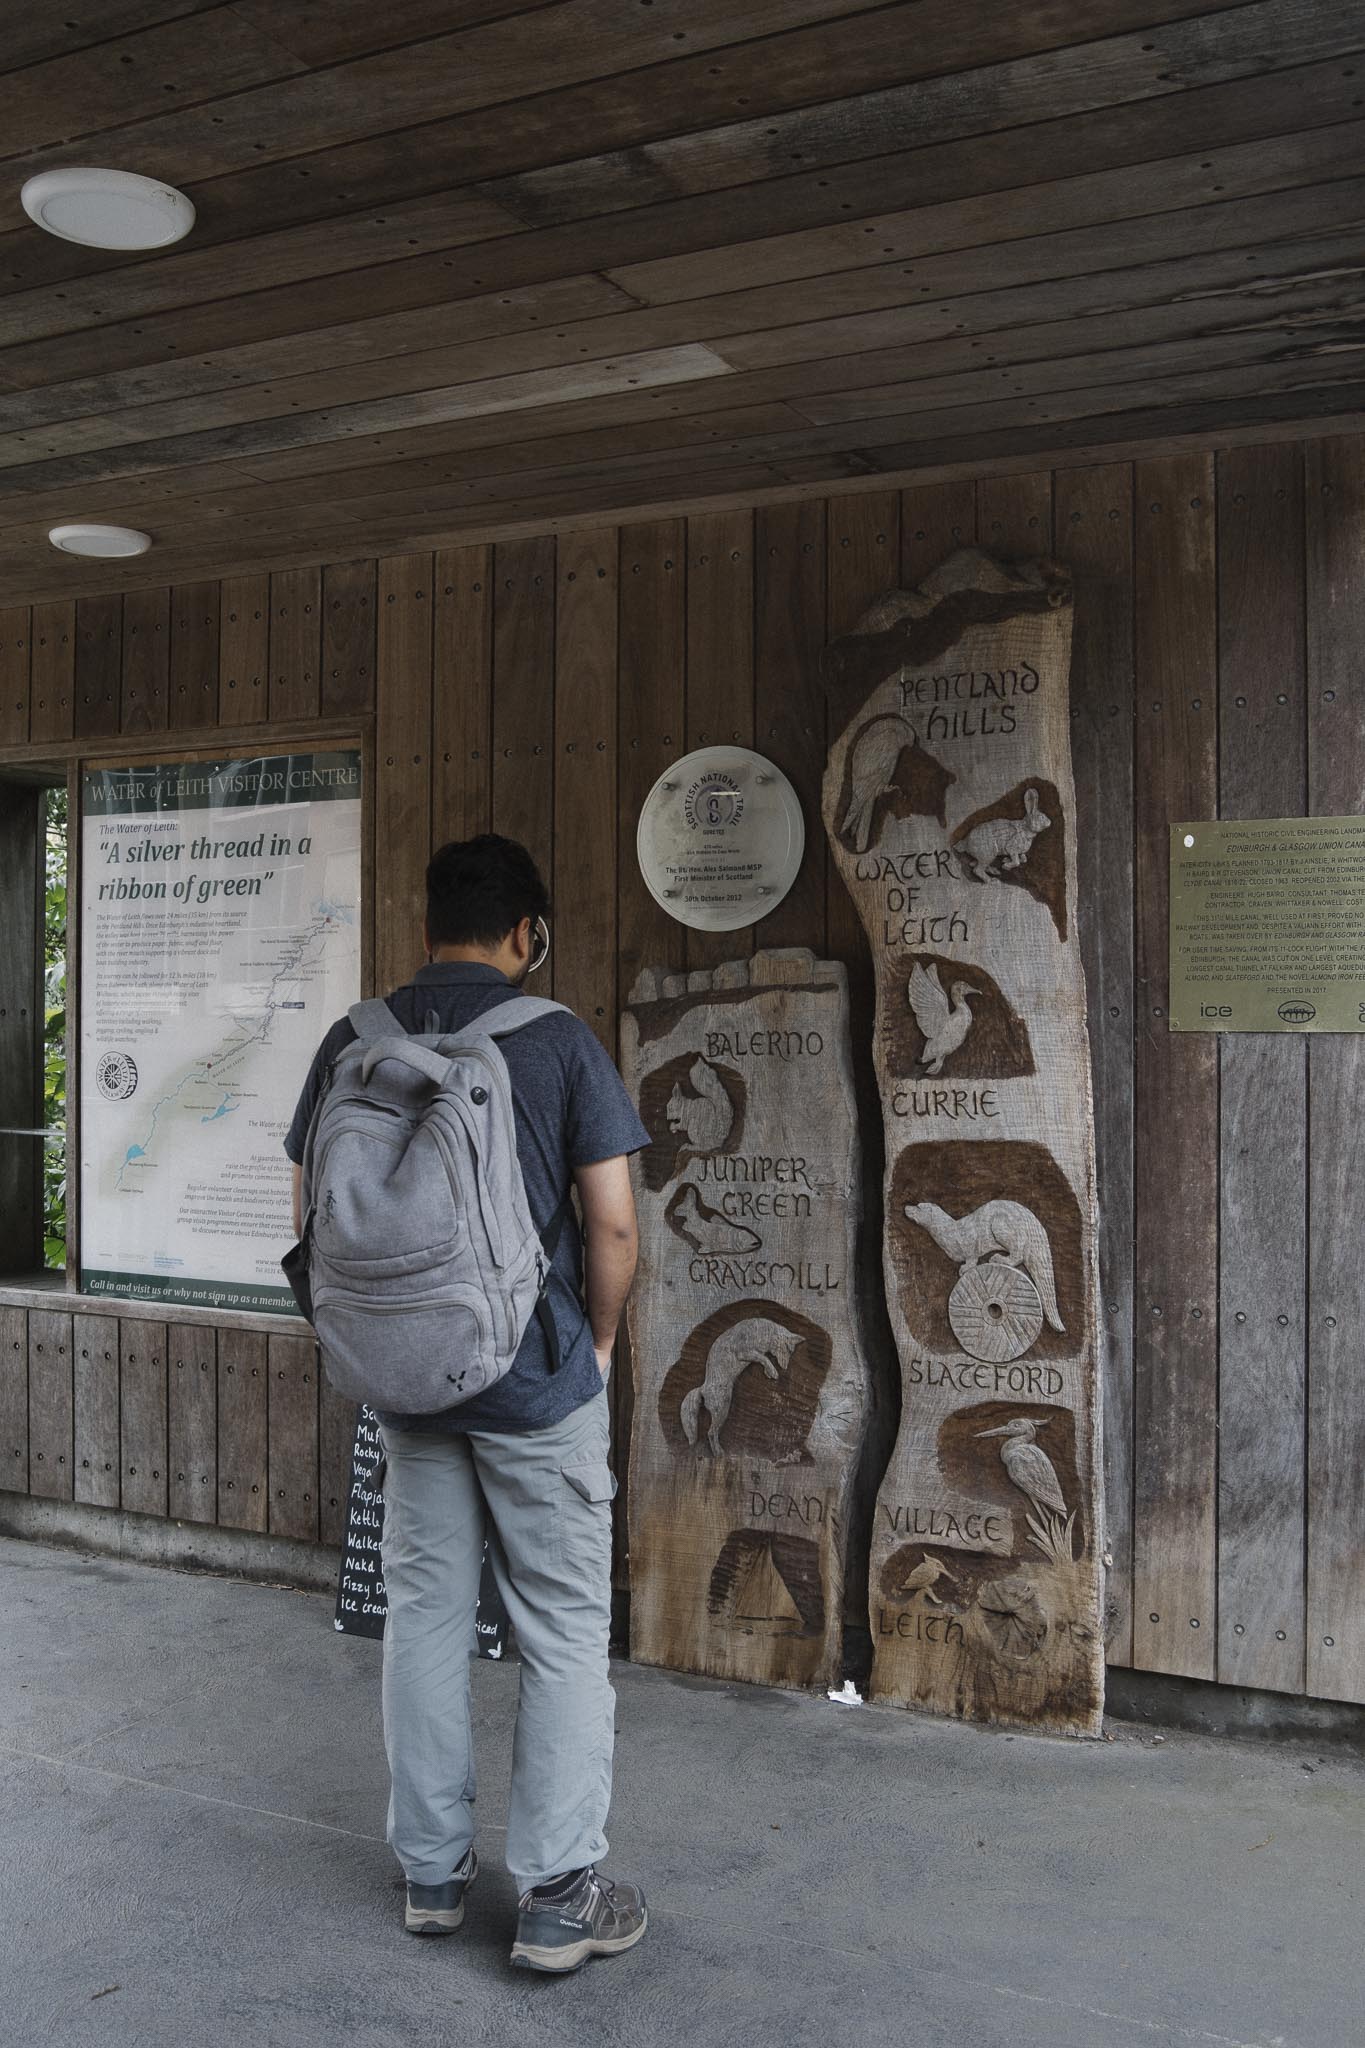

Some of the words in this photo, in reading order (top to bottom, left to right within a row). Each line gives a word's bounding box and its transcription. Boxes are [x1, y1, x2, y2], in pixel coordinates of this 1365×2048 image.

[901, 661, 1040, 706] PENTLAND
[92, 784, 145, 801] WATER
[167, 778, 212, 797] LEITH
[218, 773, 283, 794] VISITOR
[289, 768, 357, 788] CENTRE
[685, 783, 699, 830] SCOTTISH
[729, 798, 744, 827] TRAIL
[100, 824, 115, 835] The
[117, 823, 142, 834] Water
[144, 822, 153, 834] of
[1251, 830, 1279, 838] HISTORIC
[1297, 828, 1339, 837] ENGINEERING
[126, 838, 185, 863] silver
[190, 834, 264, 860] thread
[270, 834, 291, 856] in
[298, 836, 311, 855] a
[1226, 843, 1270, 853] EDINBURGH
[1279, 842, 1317, 852] GLASGOW
[1319, 841, 1343, 850] UNION
[856, 850, 960, 884] WATER
[1292, 876, 1325, 884] REOPENED
[98, 876, 166, 901] ribbon
[173, 874, 197, 904] of
[887, 887, 920, 913] OF
[1330, 888, 1356, 896] THOMAS
[1200, 1002, 1233, 1018] ice
[705, 1031, 824, 1062] BALERNO
[892, 1089, 1000, 1120] CURRIE
[697, 1157, 812, 1190] JUNIPER
[722, 1191, 811, 1221] GREEN
[688, 1258, 840, 1290] GRAYSMILL
[90, 1279, 106, 1290] Call
[107, 1280, 115, 1291] in
[116, 1281, 131, 1292] and
[133, 1283, 151, 1294] visit
[152, 1286, 161, 1295] us
[163, 1287, 172, 1296] or
[174, 1287, 190, 1300] why
[192, 1288, 207, 1299] not
[208, 1290, 226, 1304] sign
[228, 1293, 239, 1305] up
[240, 1294, 250, 1304] as
[252, 1296, 258, 1305] a
[260, 1294, 297, 1308] member
[909, 1360, 1064, 1398] SLATEFORD
[354, 1443, 380, 1465] Rocky
[350, 1507, 380, 1528] Kettle
[749, 1491, 825, 1524] DEAN
[880, 1503, 1002, 1544] VILLAGE
[475, 1621, 498, 1636] iced
